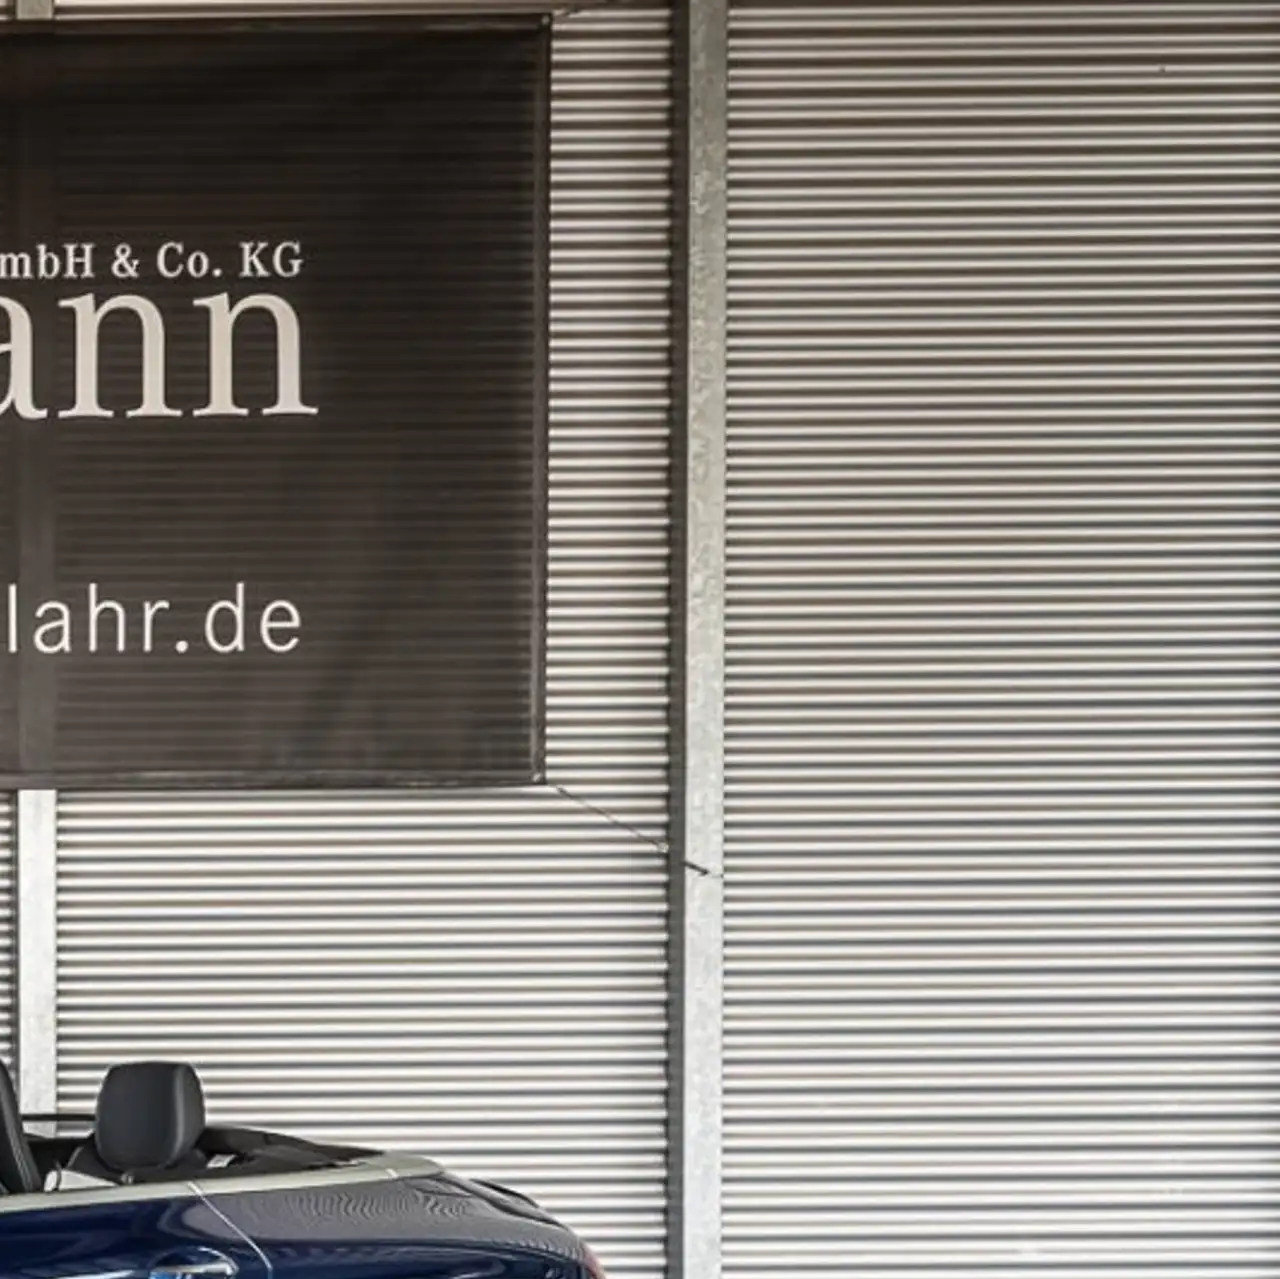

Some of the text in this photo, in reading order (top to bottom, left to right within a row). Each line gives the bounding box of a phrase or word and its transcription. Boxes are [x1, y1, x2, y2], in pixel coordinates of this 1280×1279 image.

[111, 243, 140, 278] &
[157, 242, 223, 278] Co.
[241, 241, 303, 277] KG
